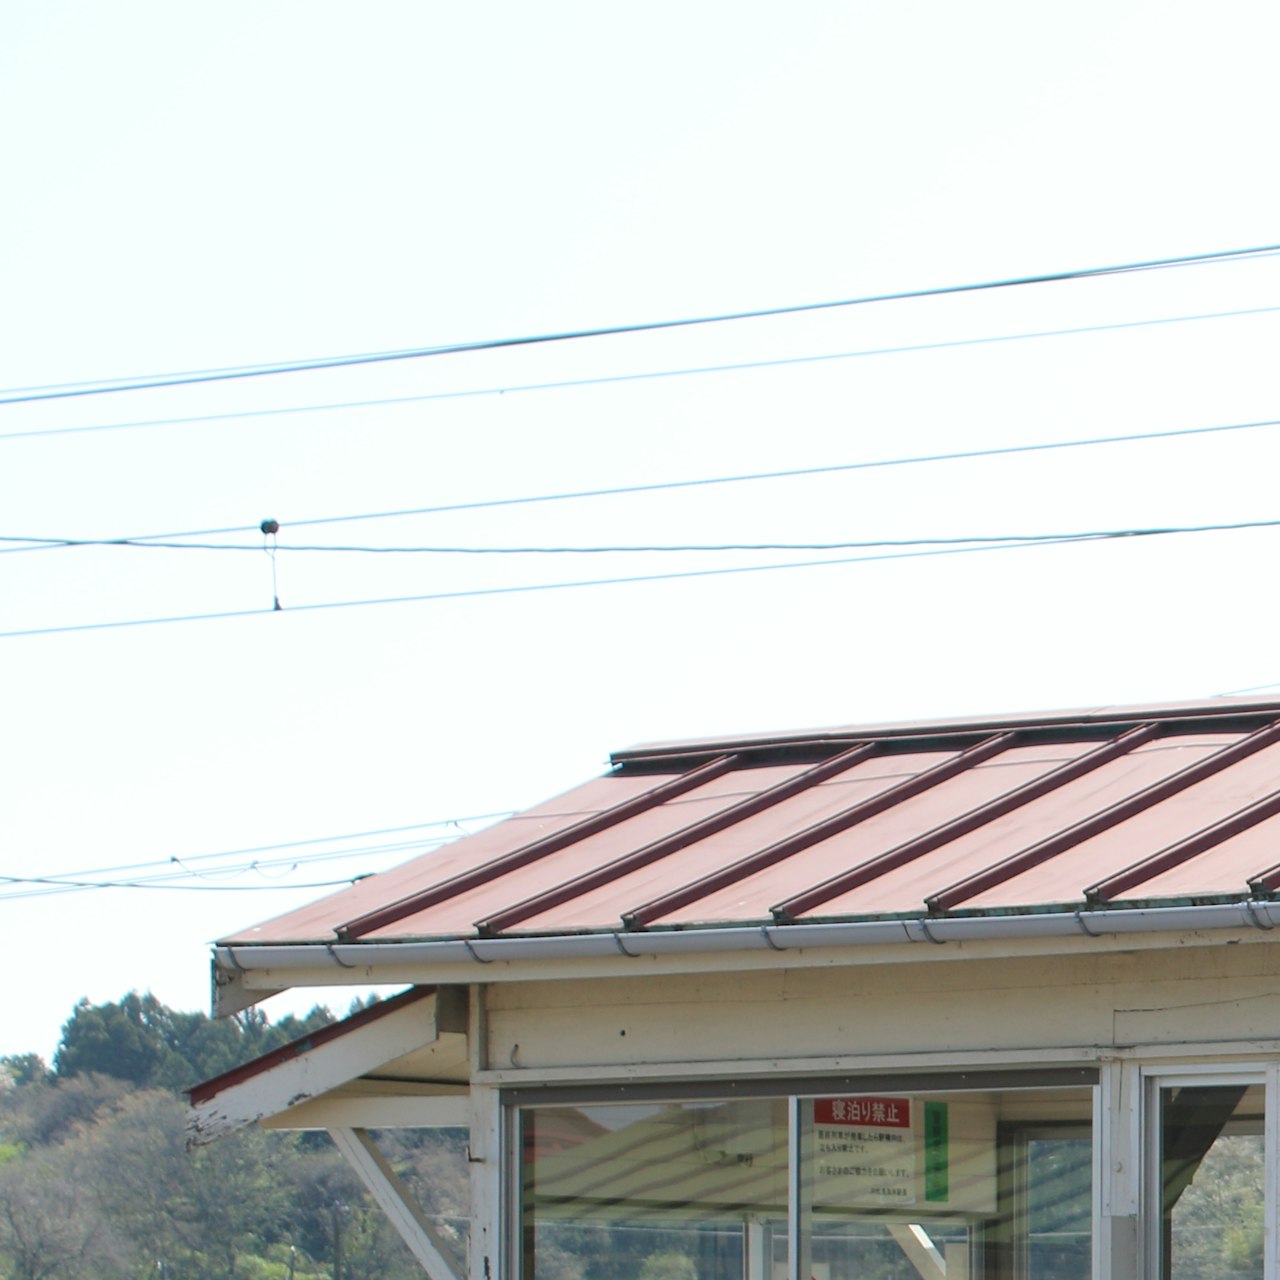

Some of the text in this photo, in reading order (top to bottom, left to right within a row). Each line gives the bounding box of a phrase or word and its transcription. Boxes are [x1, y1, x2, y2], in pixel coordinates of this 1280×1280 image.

[831, 1099, 900, 1123] 寝泊り禁止
